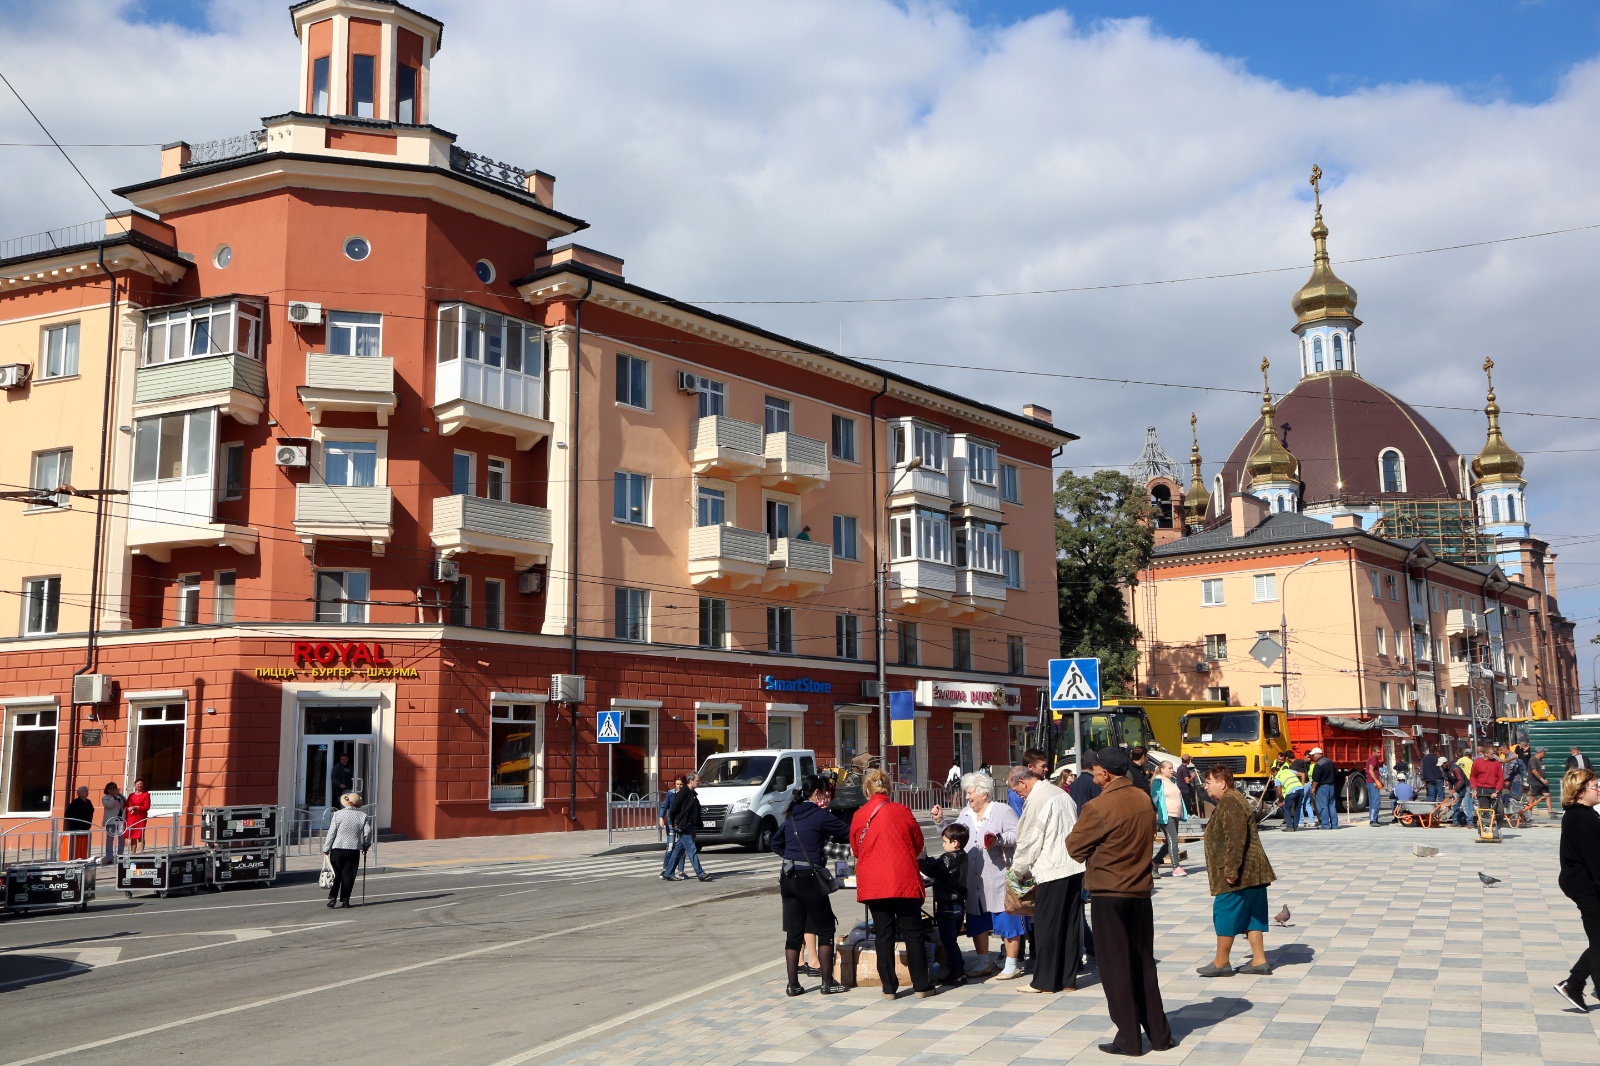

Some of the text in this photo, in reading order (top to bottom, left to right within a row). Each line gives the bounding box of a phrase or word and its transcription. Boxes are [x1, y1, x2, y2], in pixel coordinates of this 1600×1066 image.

[294, 641, 389, 664] ROYAL
[255, 667, 419, 678] ПИЦЦА БУРГЕР ШАУРМА
[765, 675, 832, 693] SmartStore
[31, 882, 69, 891] SOLARIS
